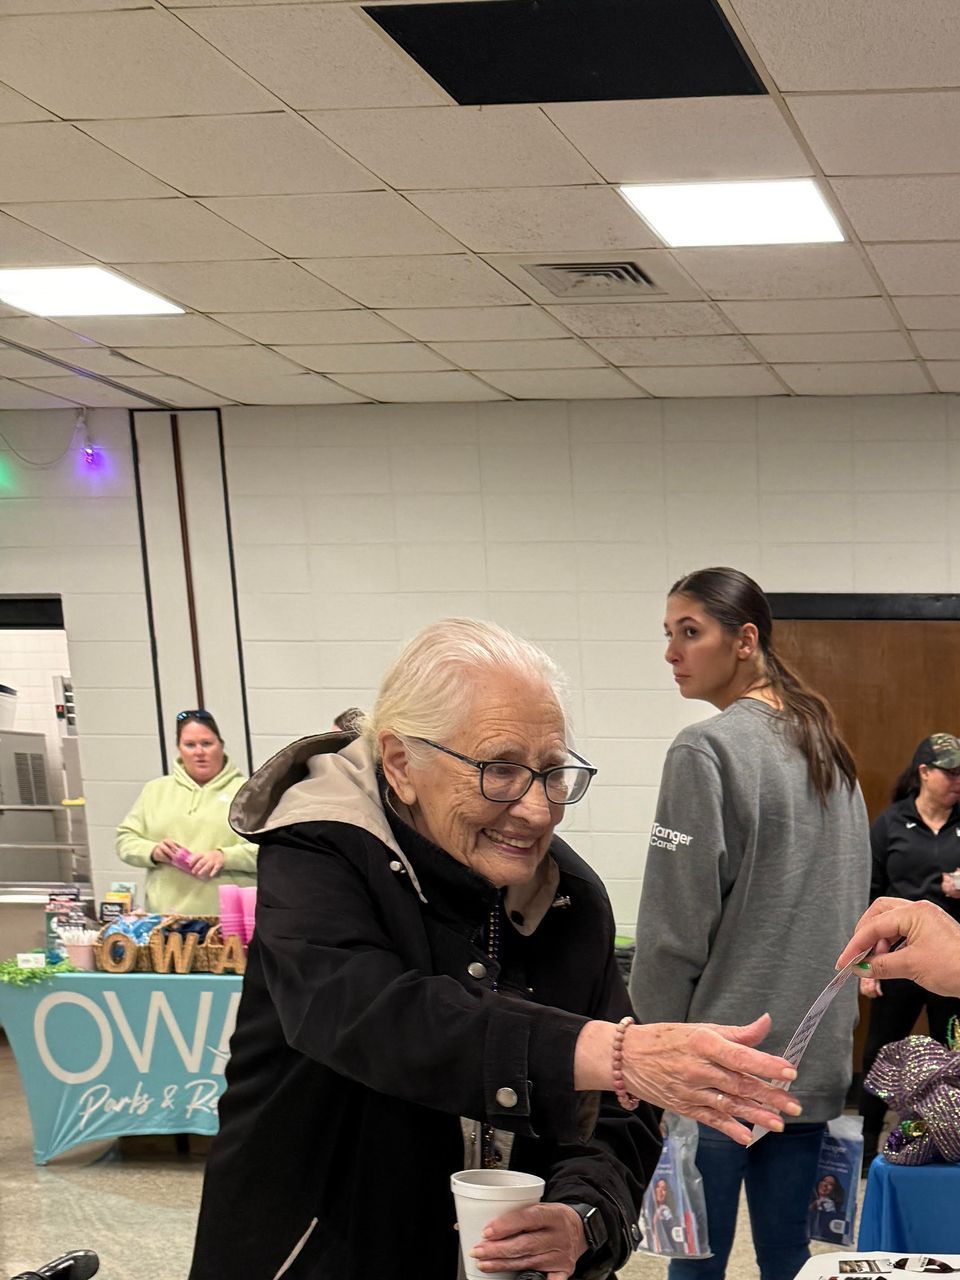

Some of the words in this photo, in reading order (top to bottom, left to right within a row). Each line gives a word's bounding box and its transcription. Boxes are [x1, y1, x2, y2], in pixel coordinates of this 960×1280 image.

[650, 836, 677, 852] Cares
[651, 822, 693, 846] Tanger
[79, 1081, 154, 1130] Parks
[160, 1084, 178, 1110] &
